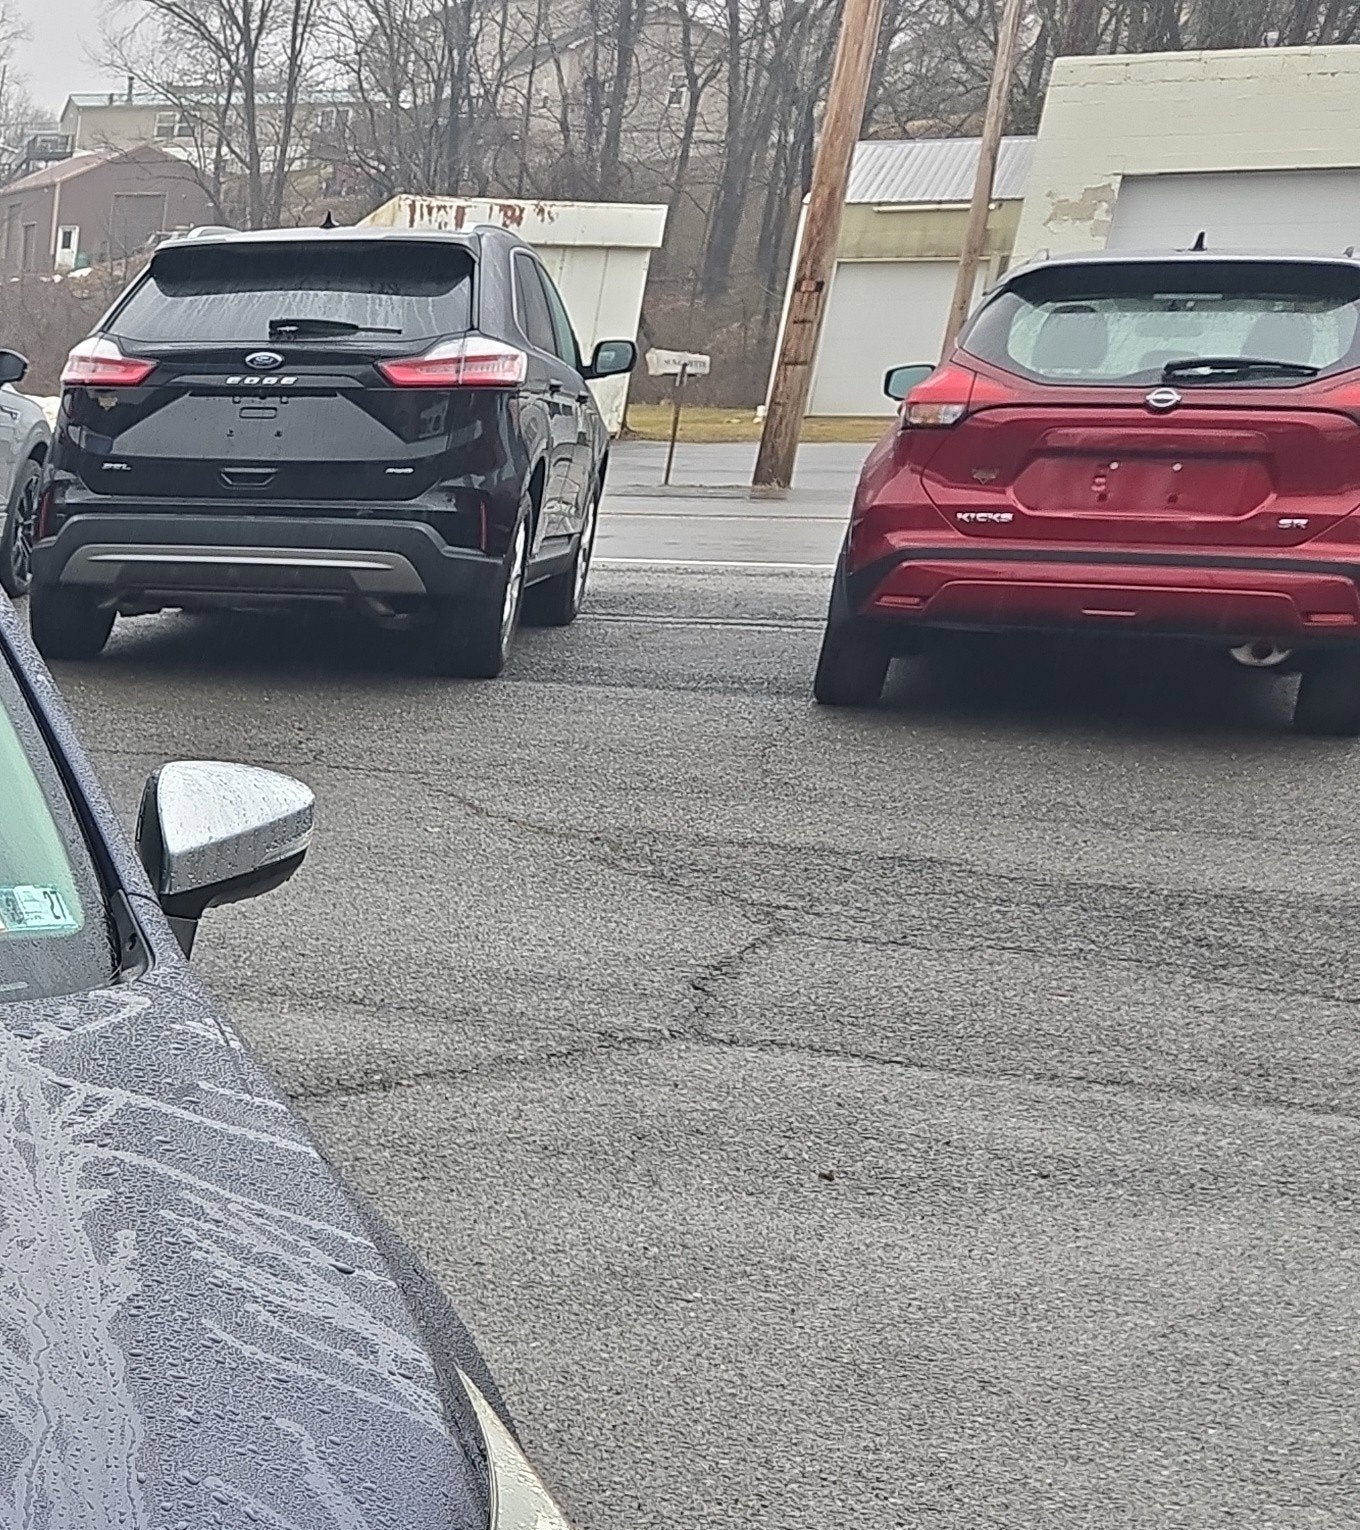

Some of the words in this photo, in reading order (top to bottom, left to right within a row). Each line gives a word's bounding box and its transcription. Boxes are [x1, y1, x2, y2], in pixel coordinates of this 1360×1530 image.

[226, 376, 298, 385] EDGE
[956, 512, 1014, 523] KICKS
[1278, 518, 1309, 529] SR
